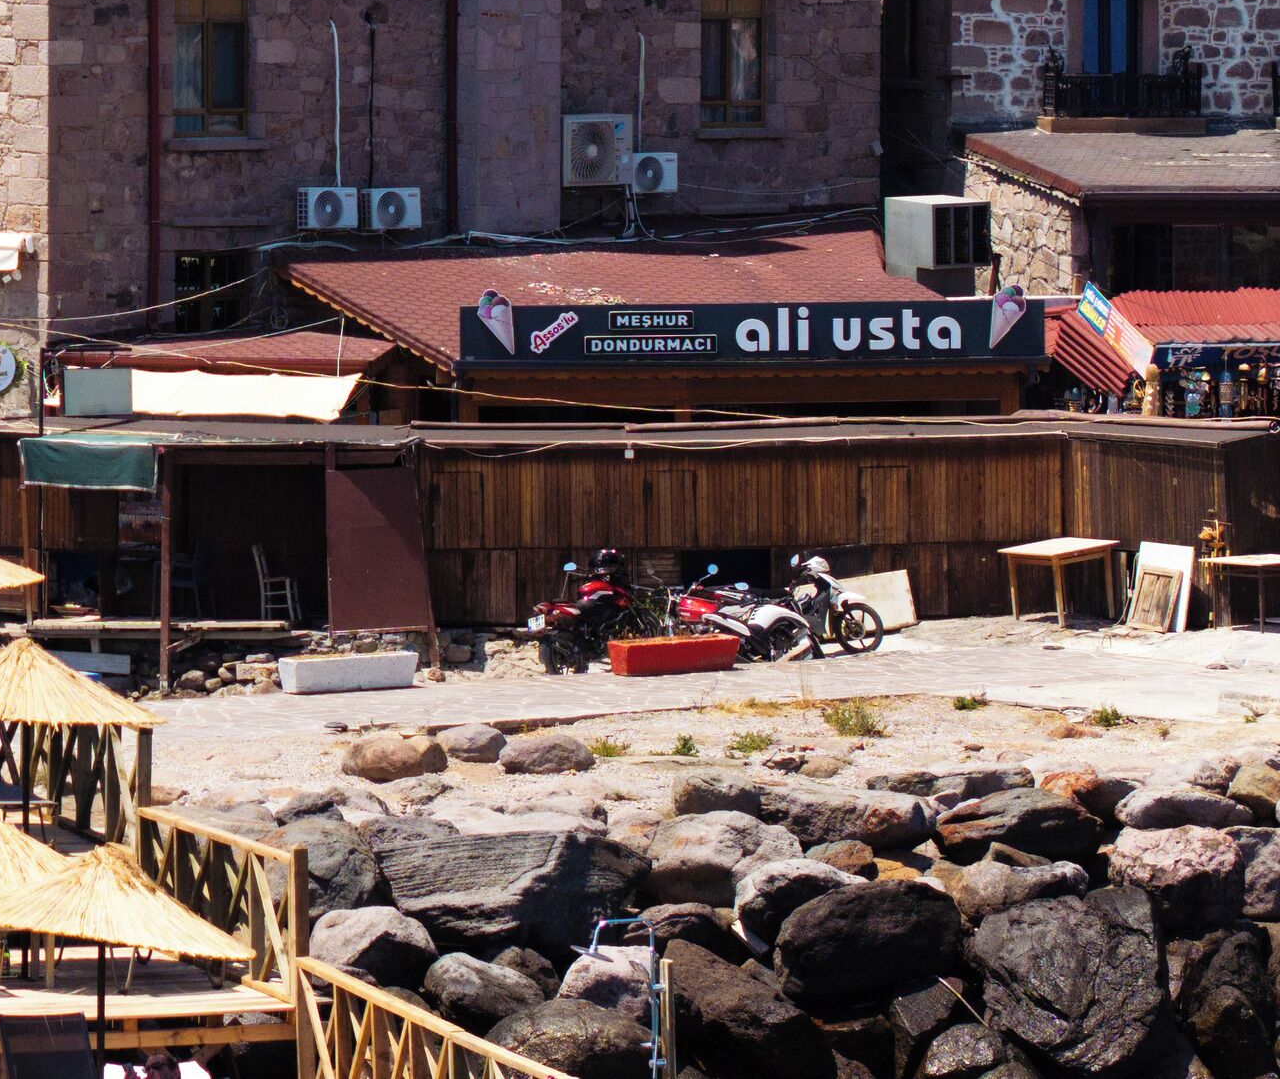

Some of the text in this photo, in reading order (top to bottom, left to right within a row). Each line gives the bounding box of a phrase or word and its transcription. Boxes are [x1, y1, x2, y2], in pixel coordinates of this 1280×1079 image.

[616, 314, 689, 328] MEŞHUR
[735, 306, 963, 352] ali usta
[591, 338, 712, 352] DONDURMACI
